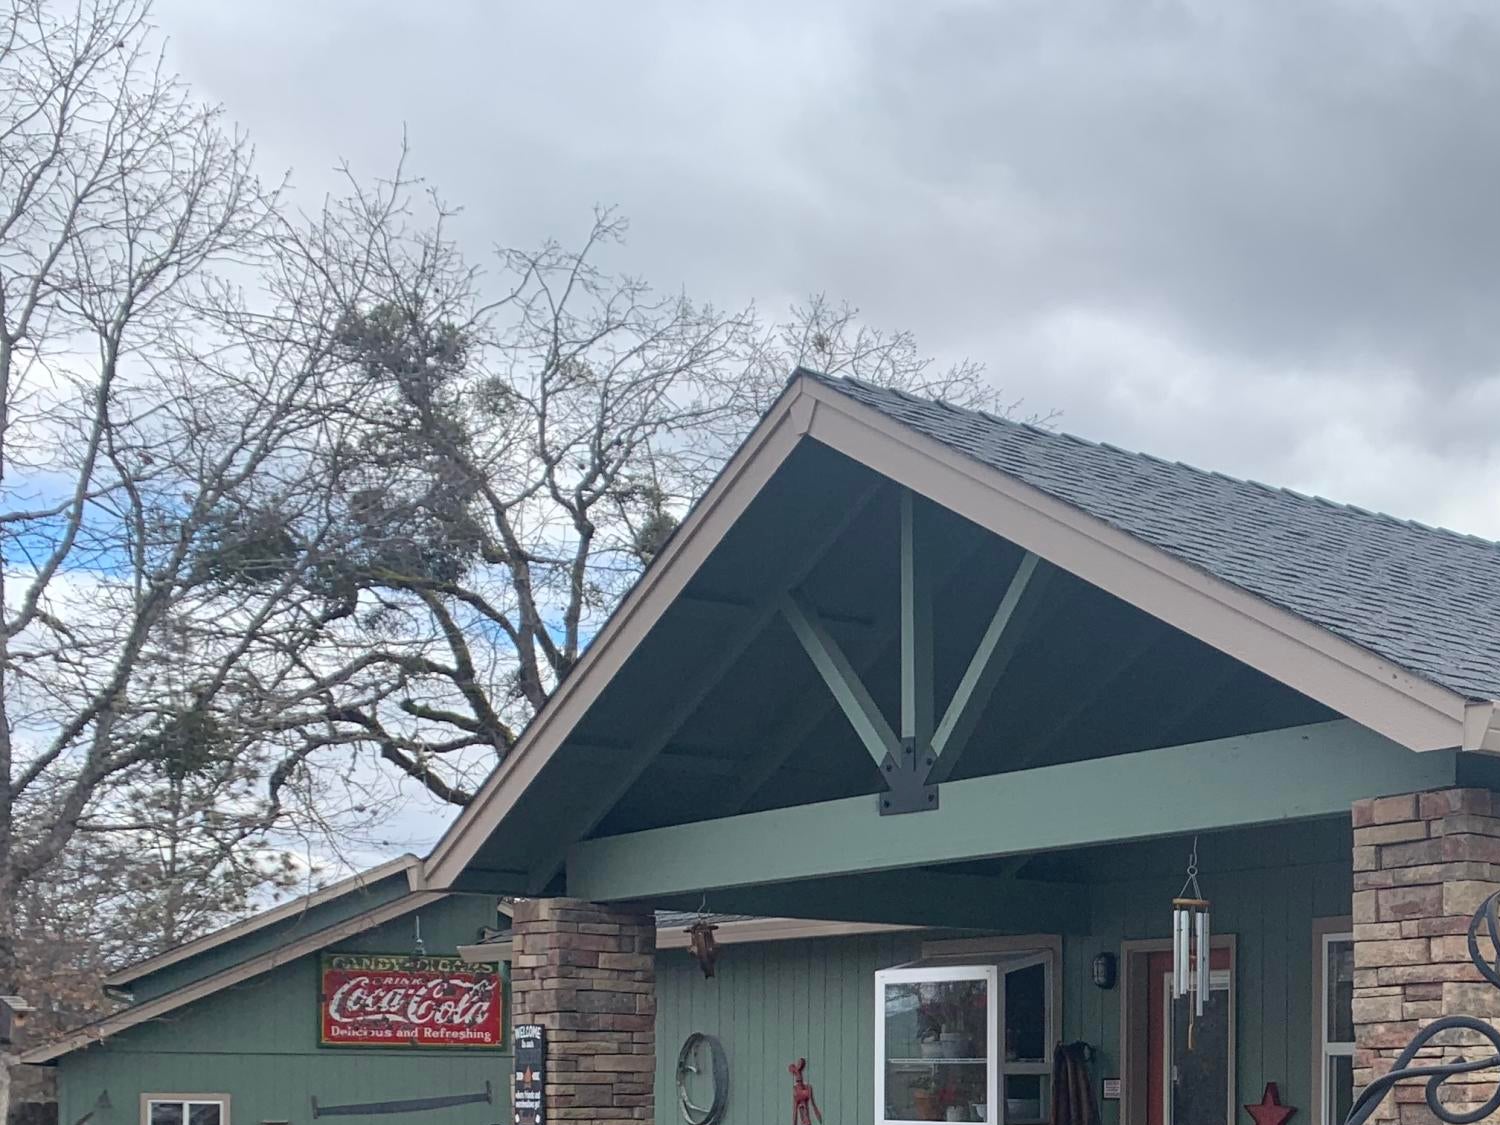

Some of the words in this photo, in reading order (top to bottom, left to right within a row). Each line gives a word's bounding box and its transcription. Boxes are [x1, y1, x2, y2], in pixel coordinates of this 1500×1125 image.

[329, 976, 497, 1025] Coca-Cola
[331, 1025, 393, 1038] Delicious
[396, 1027, 419, 1038] and
[423, 1027, 492, 1042] Refreshing
[514, 1025, 542, 1040] WELCOME
